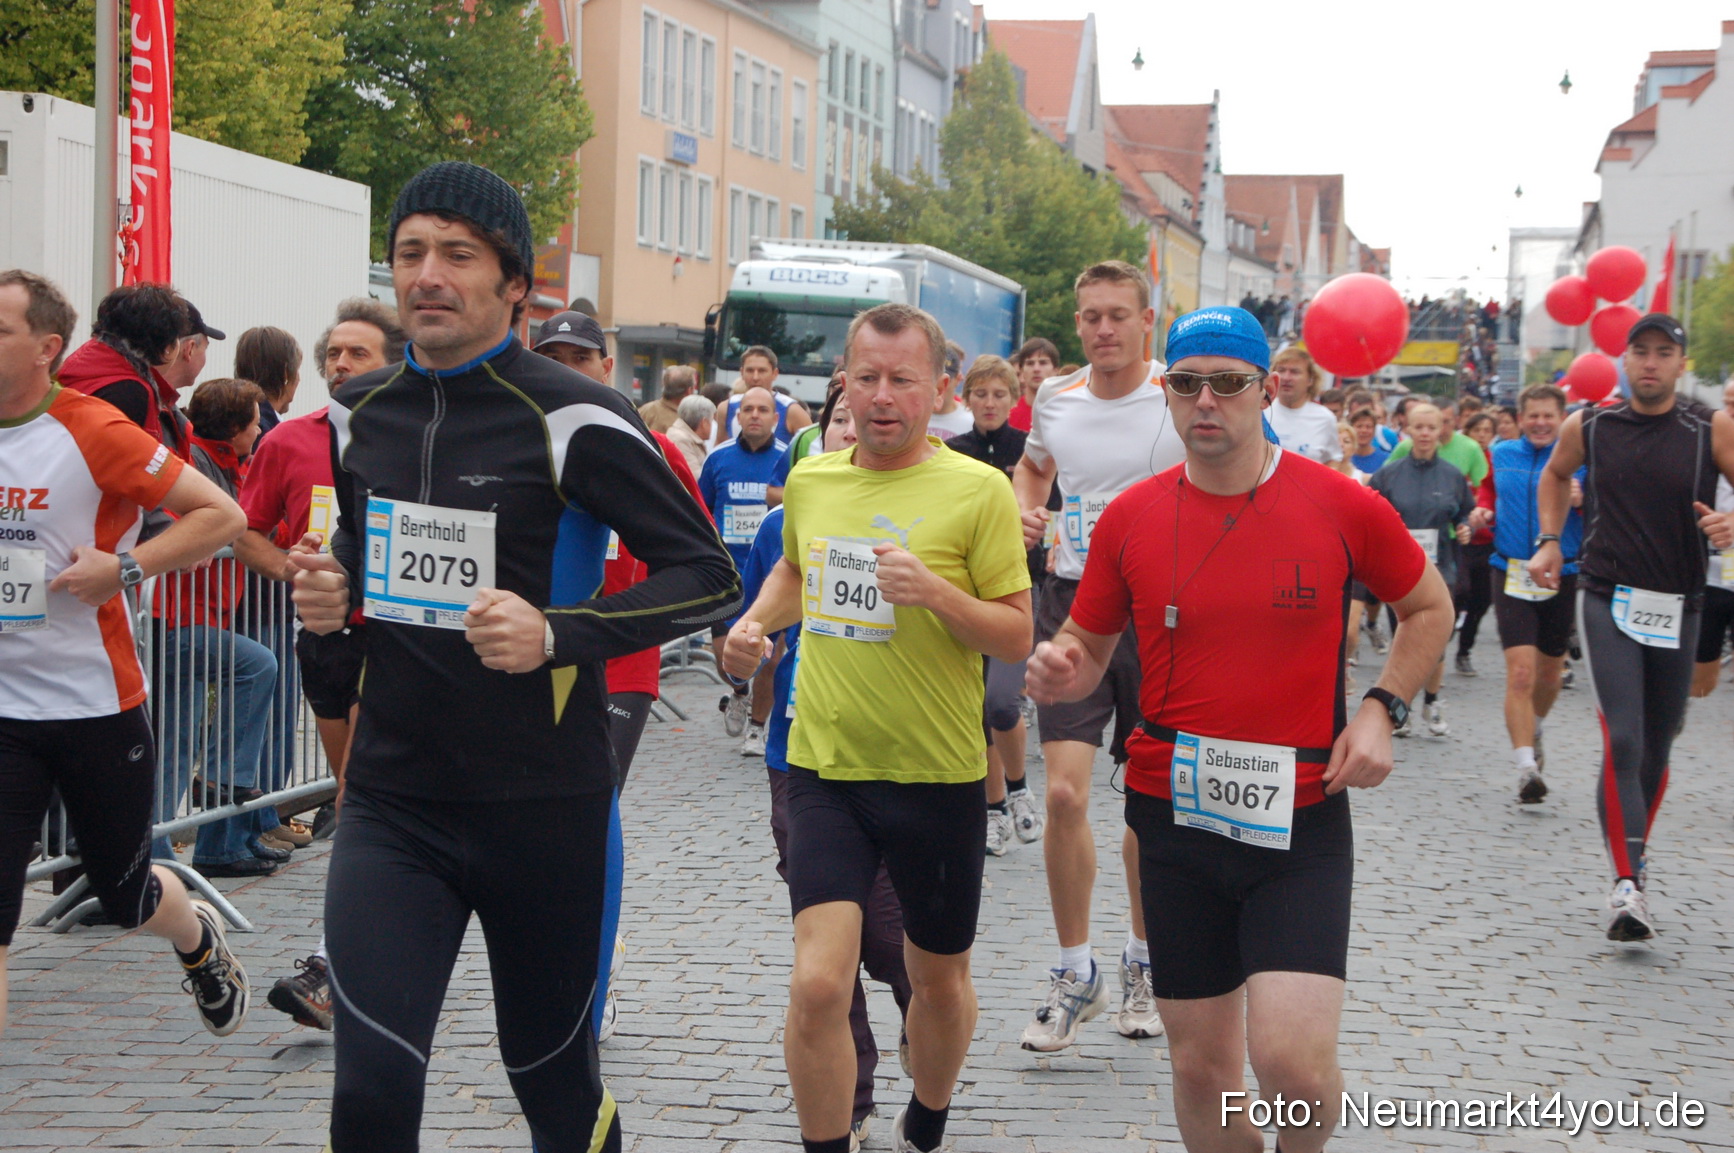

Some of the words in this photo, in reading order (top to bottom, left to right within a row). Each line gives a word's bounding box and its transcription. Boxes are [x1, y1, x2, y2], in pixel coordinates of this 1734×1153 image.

[400, 514, 466, 543] Berthold
[400, 550, 479, 588] 2079
[828, 549, 878, 573] Richard
[834, 580, 878, 611] 940
[1632, 610, 1674, 629] 2272
[1205, 747, 1279, 774] Sebastian
[1179, 771, 1187, 784] B
[1207, 777, 1280, 811] 3067
[1241, 828, 1288, 844] PFLEIDERER
